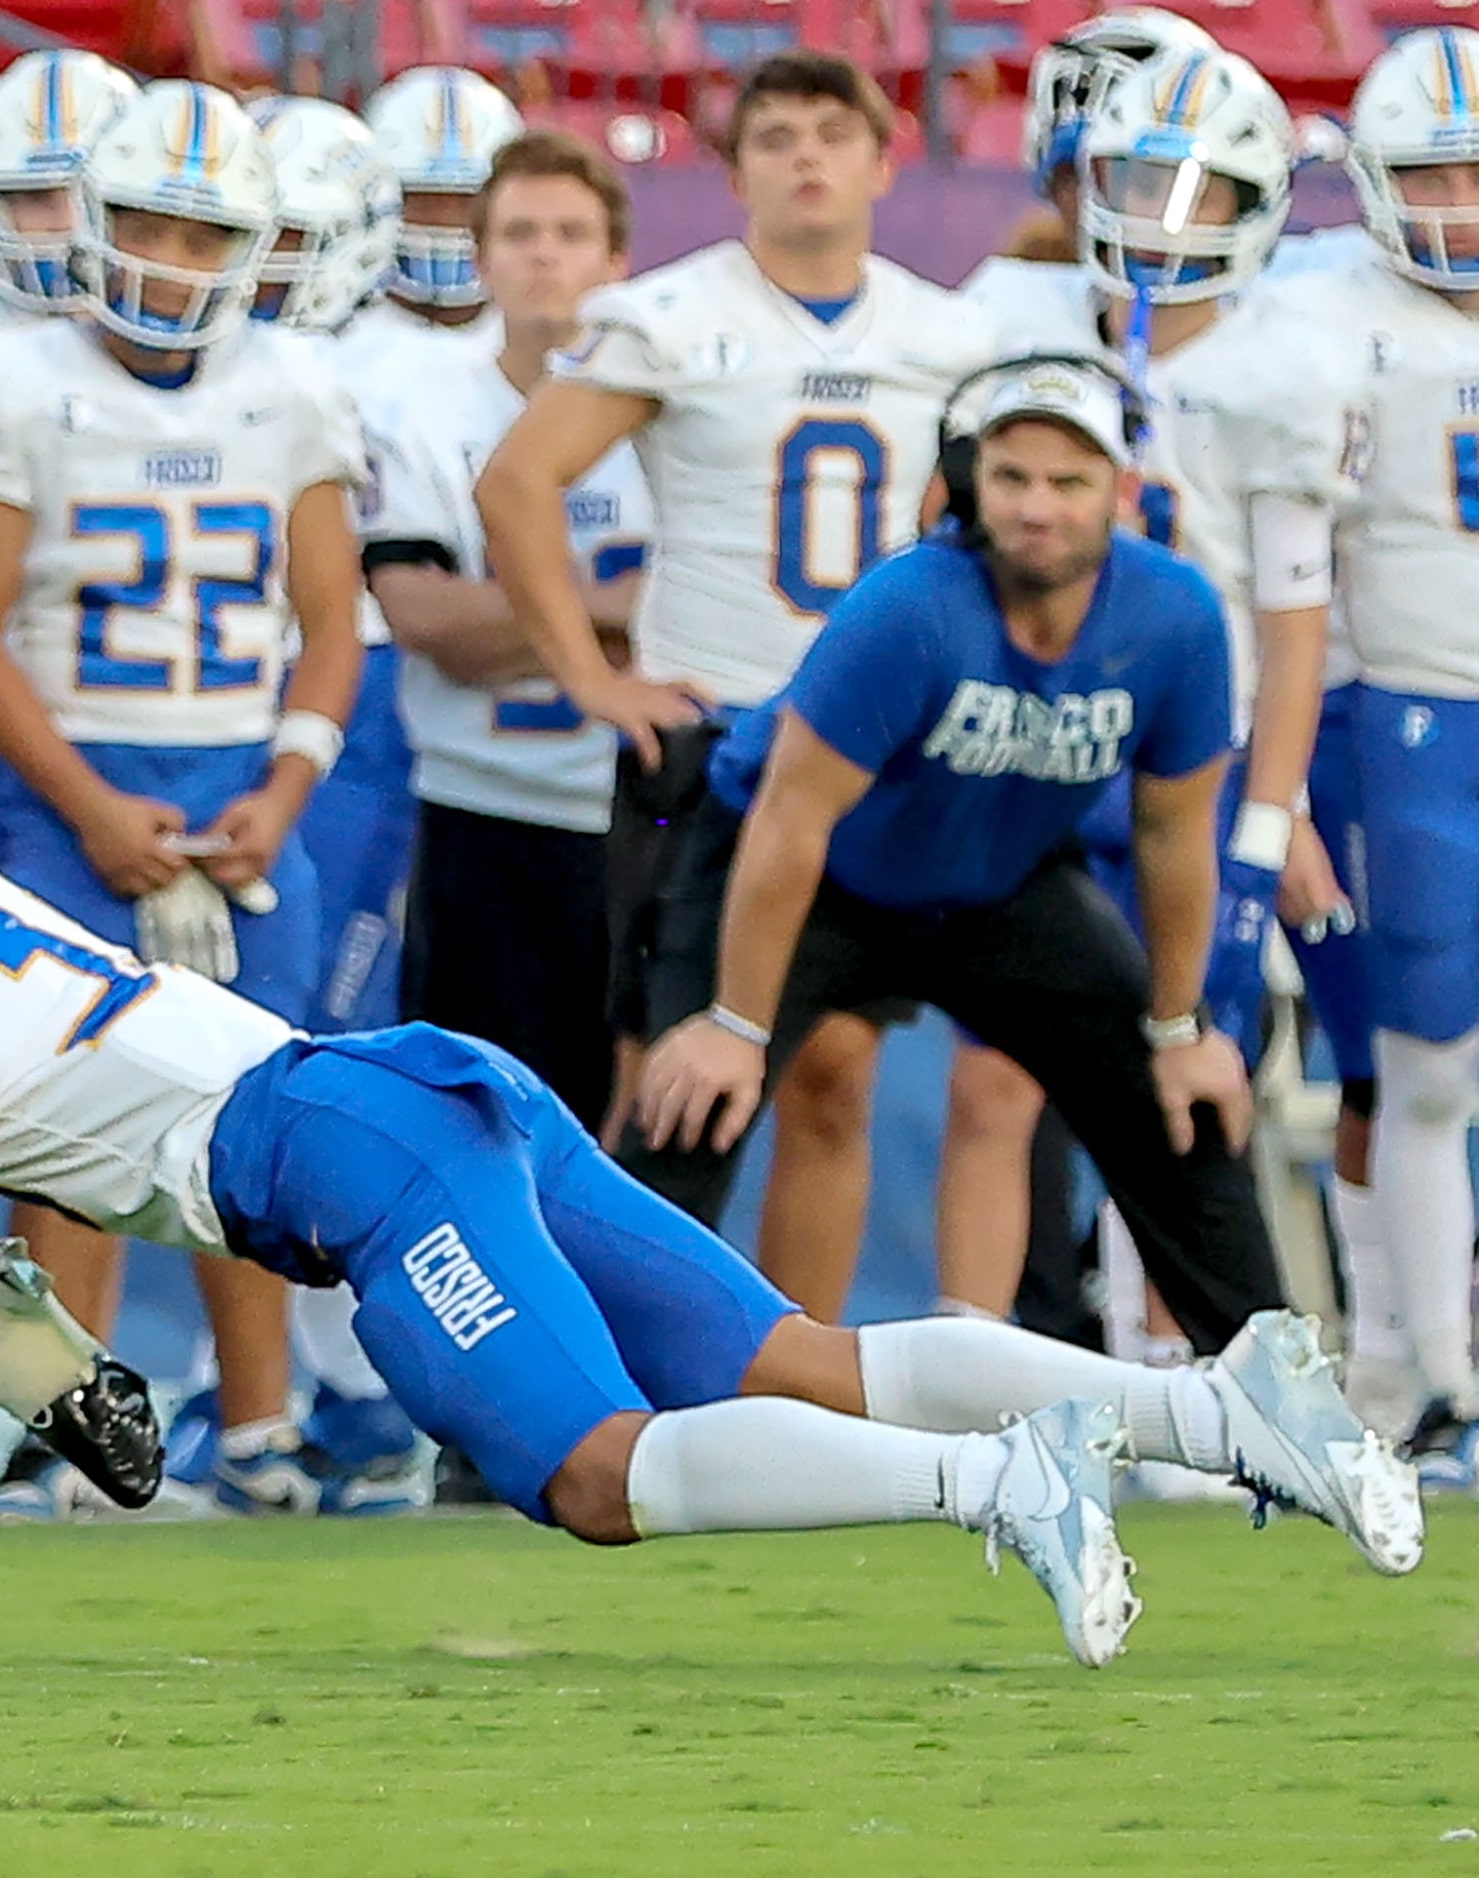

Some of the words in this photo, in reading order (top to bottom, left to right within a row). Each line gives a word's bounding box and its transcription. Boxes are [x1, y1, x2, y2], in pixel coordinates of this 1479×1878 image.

[69, 498, 275, 692] 22
[768, 412, 888, 620] 0
[402, 1222, 518, 1350] FRISCO
